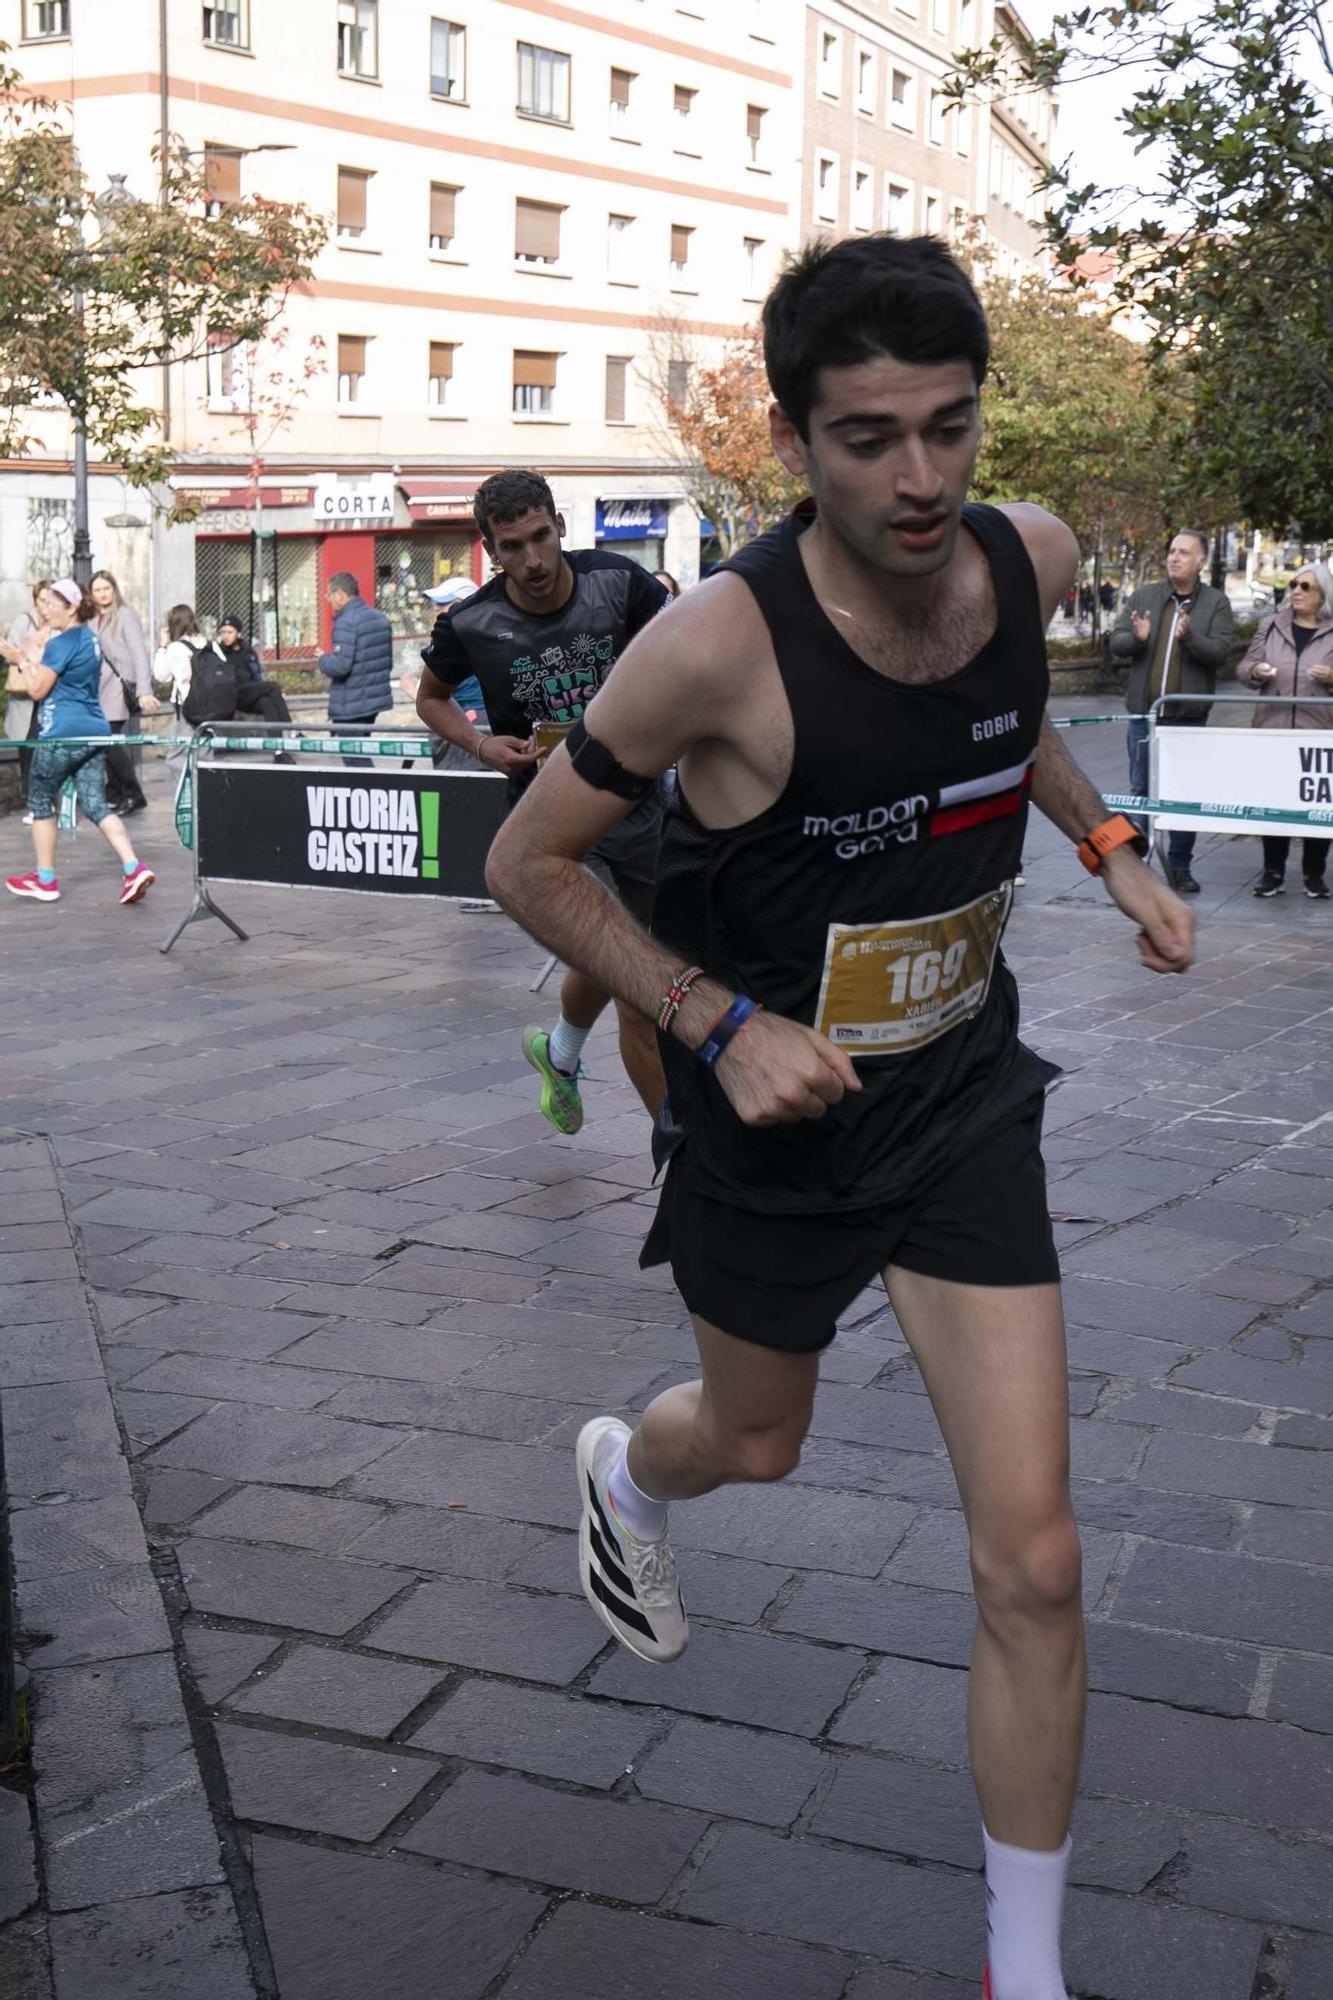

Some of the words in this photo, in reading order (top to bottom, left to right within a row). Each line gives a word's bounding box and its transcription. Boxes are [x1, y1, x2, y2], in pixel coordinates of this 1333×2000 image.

[324, 496, 391, 514] CORTA
[544, 668, 594, 695] RUN
[971, 709, 1020, 742] GOBIK
[306, 786, 419, 833] VITORIA
[307, 830, 419, 878] GASTEIZ
[886, 939, 968, 1004] 169
